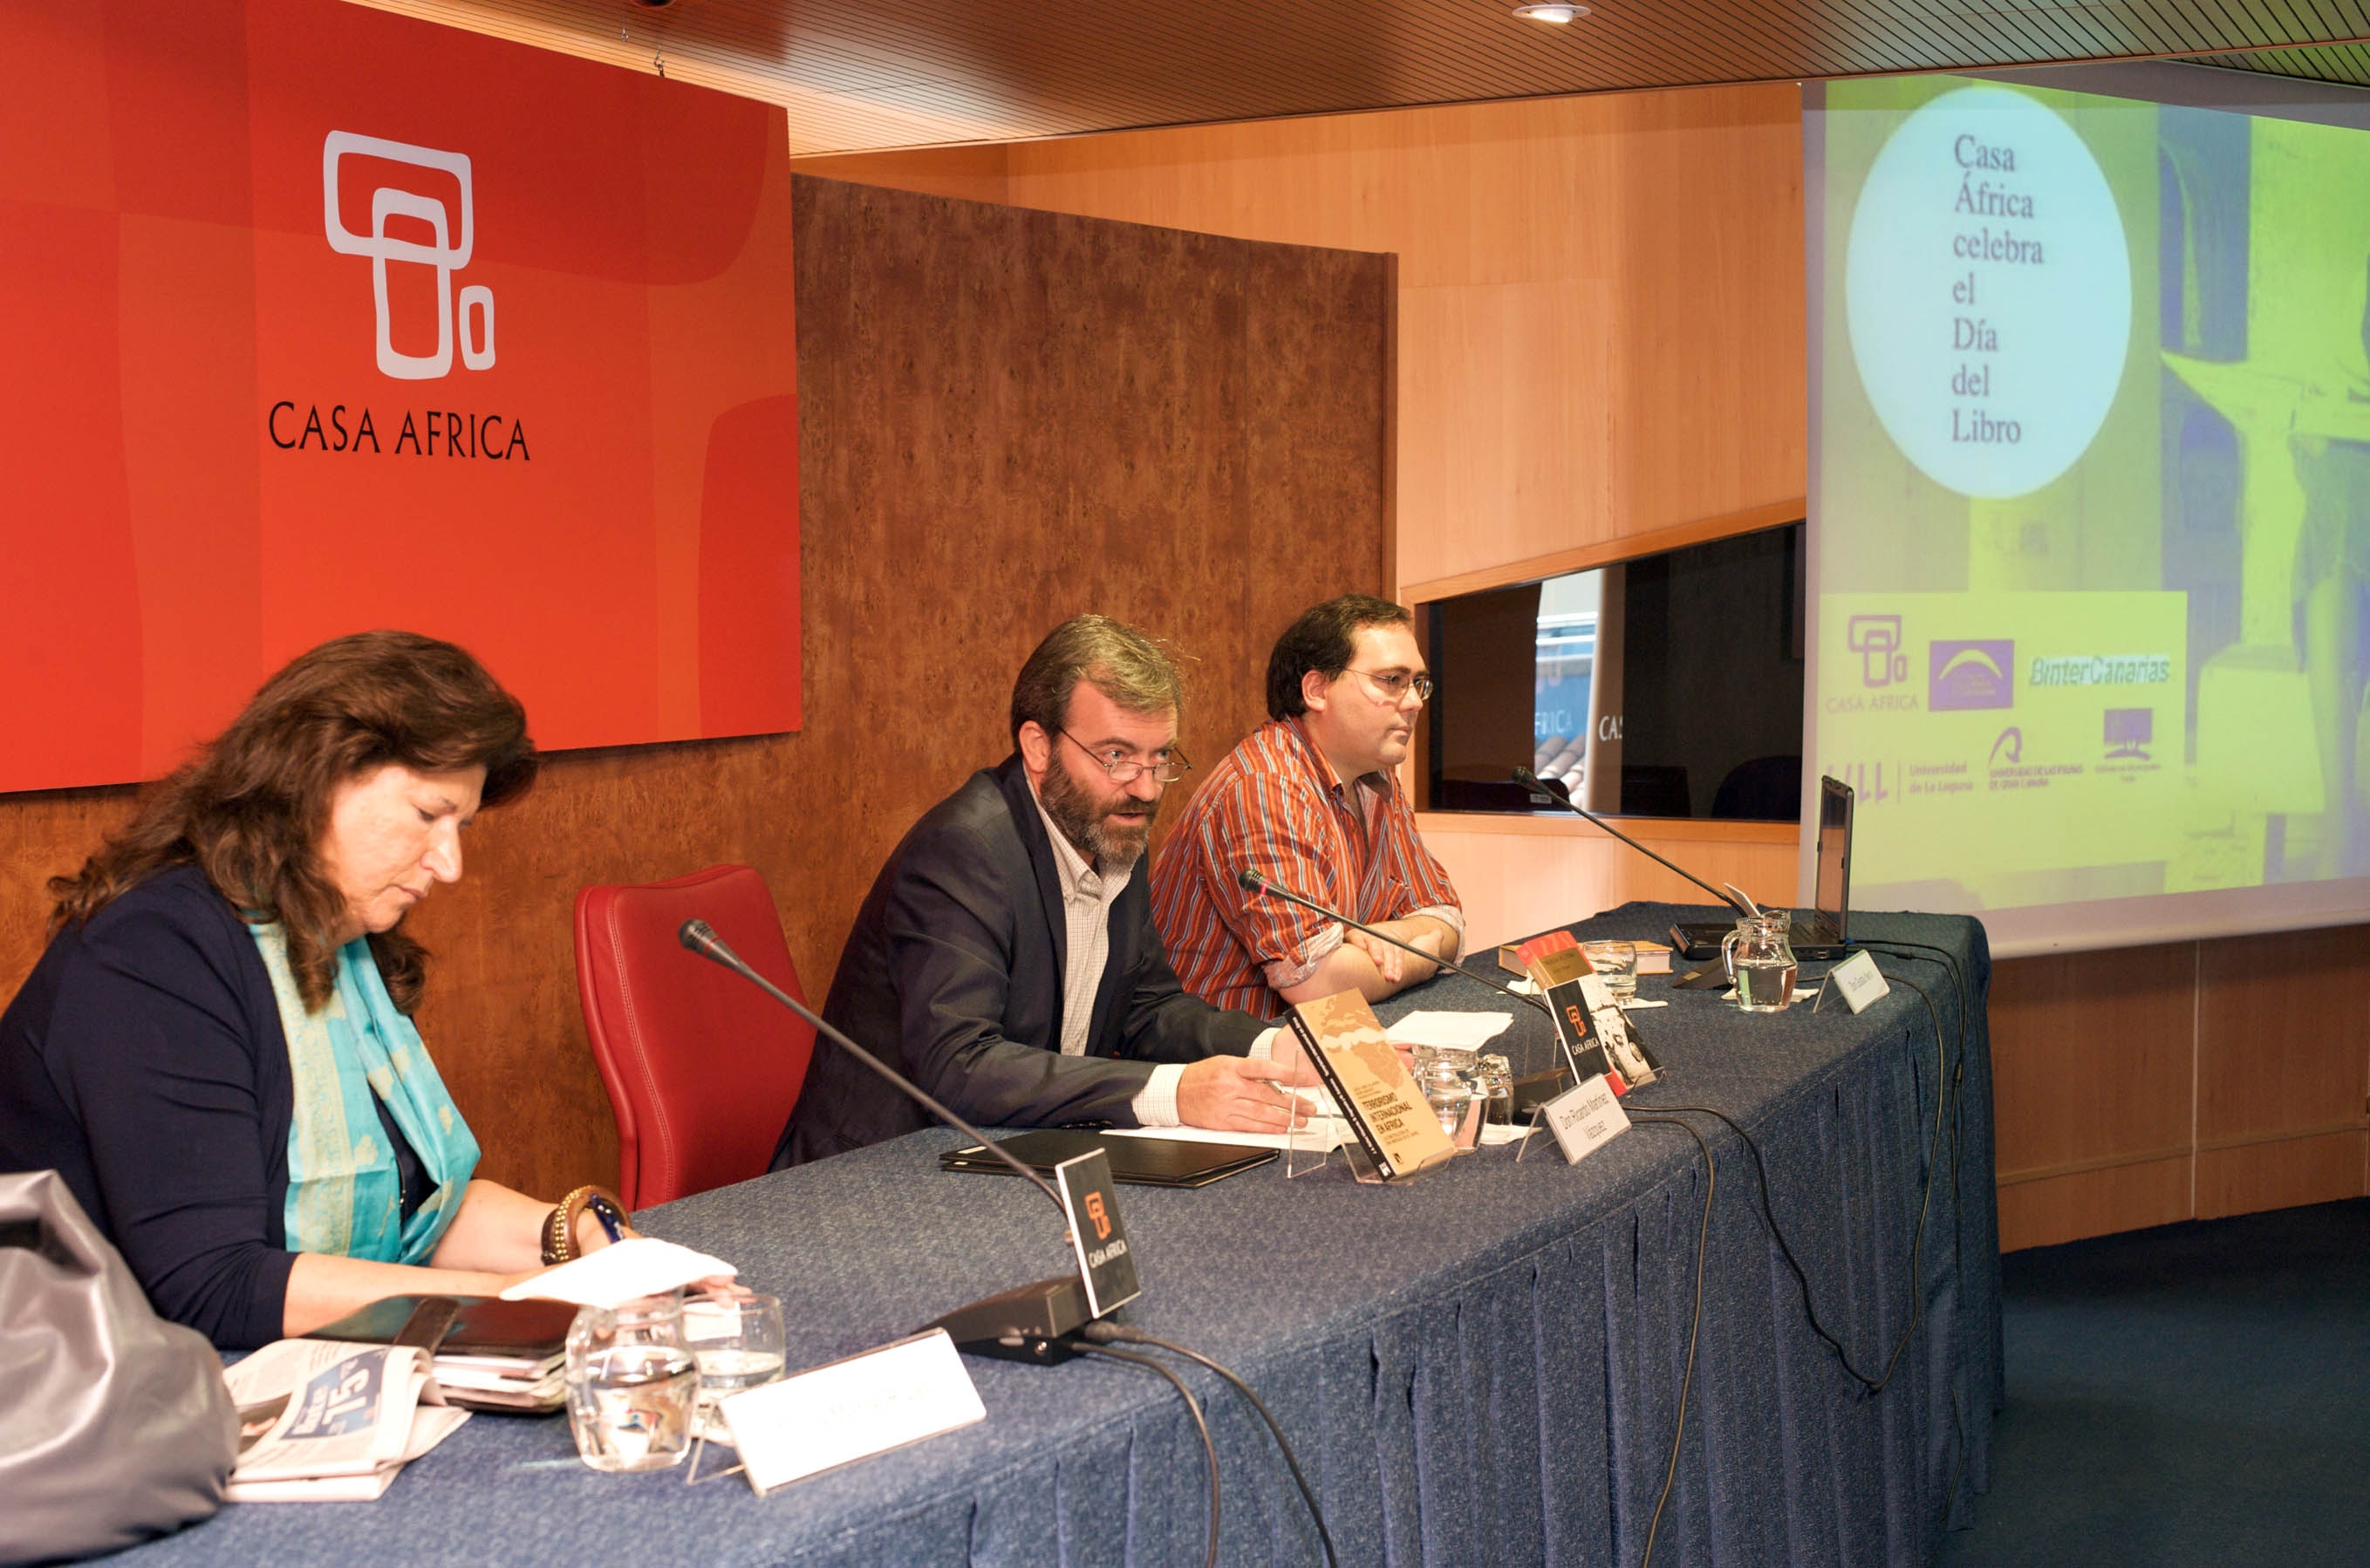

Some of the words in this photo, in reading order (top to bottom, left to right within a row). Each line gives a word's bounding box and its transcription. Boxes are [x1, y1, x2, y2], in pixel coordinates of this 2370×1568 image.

[1954, 133, 2015, 172] Casa
[1955, 170, 2034, 218] África
[1953, 227, 2044, 263] celebra
[1953, 271, 1975, 304] el
[1952, 317, 1998, 351] Día
[1951, 363, 1990, 397] del
[269, 400, 380, 453] CASA
[394, 410, 530, 461] AFRICA
[1952, 408, 2022, 444] Libro
[1826, 696, 1864, 713] CASA
[1868, 694, 1919, 712] AFRICA
[1571, 1044, 1585, 1056] CASA
[1583, 1037, 1600, 1053] AFRICA
[1362, 1092, 1398, 1111] TERRORISMO
[1369, 1101, 1413, 1123] INTERNACIONAL
[1559, 1115, 1573, 1130] Don
[1088, 1248, 1107, 1269] CASA
[1105, 1238, 1129, 1260] AFRICA
